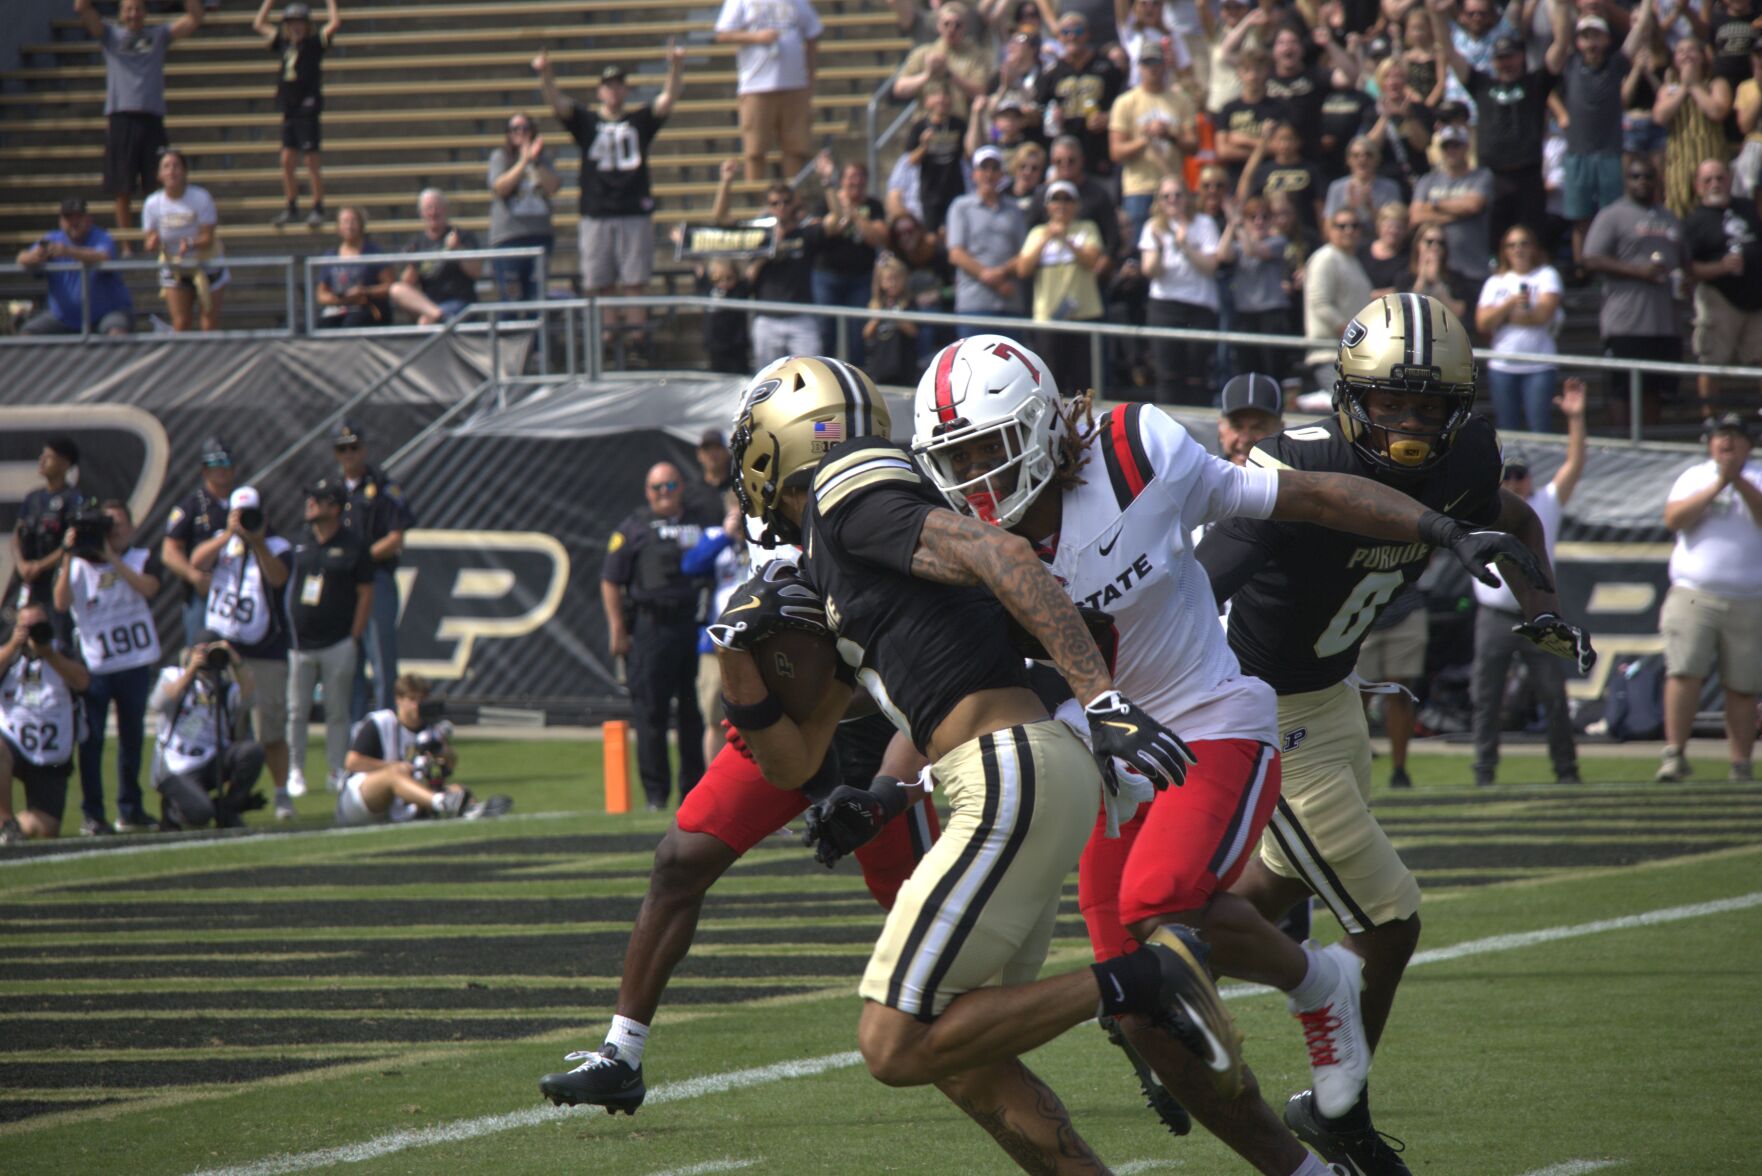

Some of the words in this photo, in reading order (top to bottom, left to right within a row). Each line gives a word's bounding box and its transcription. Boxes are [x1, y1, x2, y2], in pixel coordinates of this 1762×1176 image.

[587, 120, 642, 171] 40
[992, 342, 1041, 386] 7
[1346, 542, 1431, 569] PURDUE
[1073, 553, 1153, 611] TATE
[207, 585, 256, 624] 159
[97, 620, 152, 659] 190
[1283, 726, 1307, 753] P
